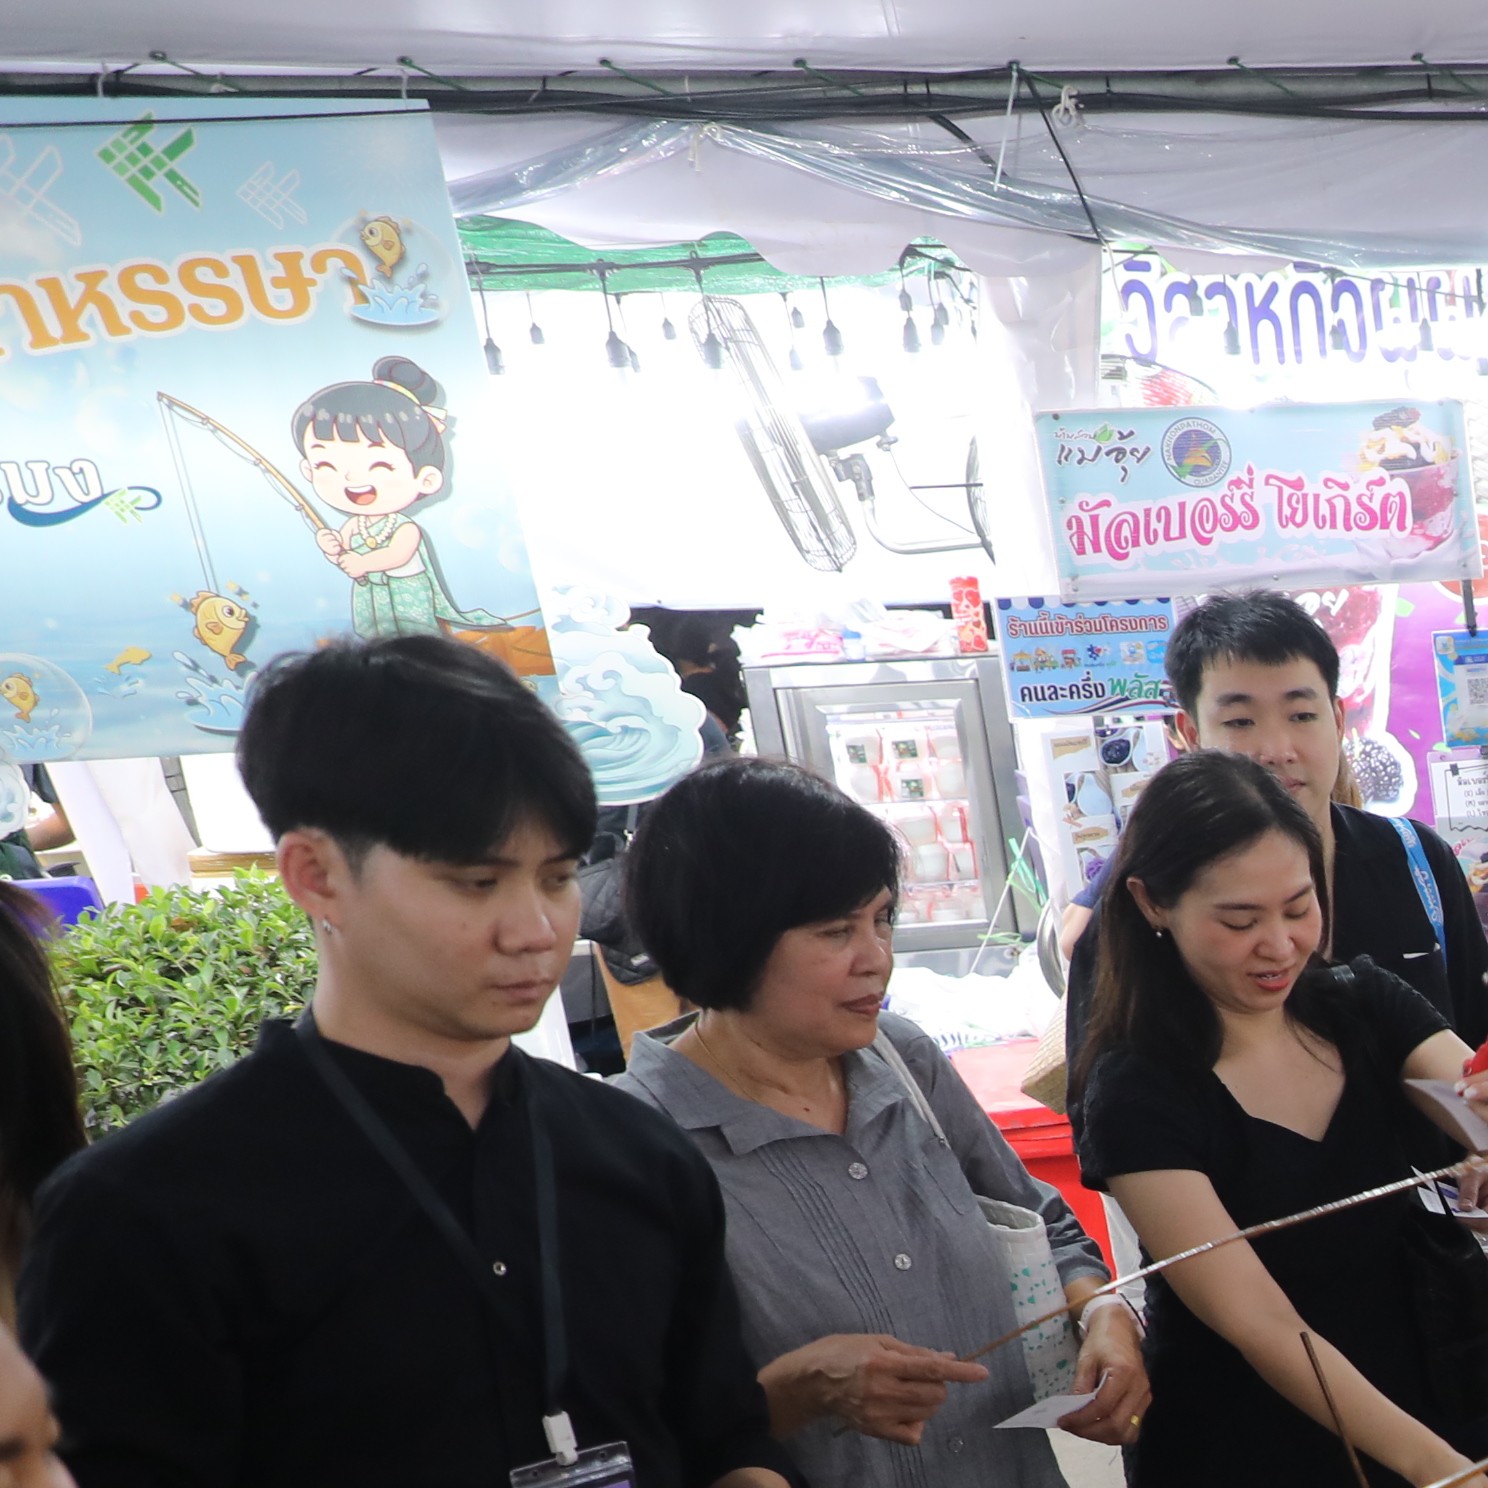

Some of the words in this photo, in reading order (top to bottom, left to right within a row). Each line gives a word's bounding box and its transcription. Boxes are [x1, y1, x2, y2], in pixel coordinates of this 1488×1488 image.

[1163, 420, 1217, 462] NAKHONPATHOM
[1008, 611, 1168, 638] ร้านนี้เข้าร่วมโครงการ
[1020, 671, 1105, 703] คนละครึ่ง
[1108, 672, 1161, 700] พลัส
